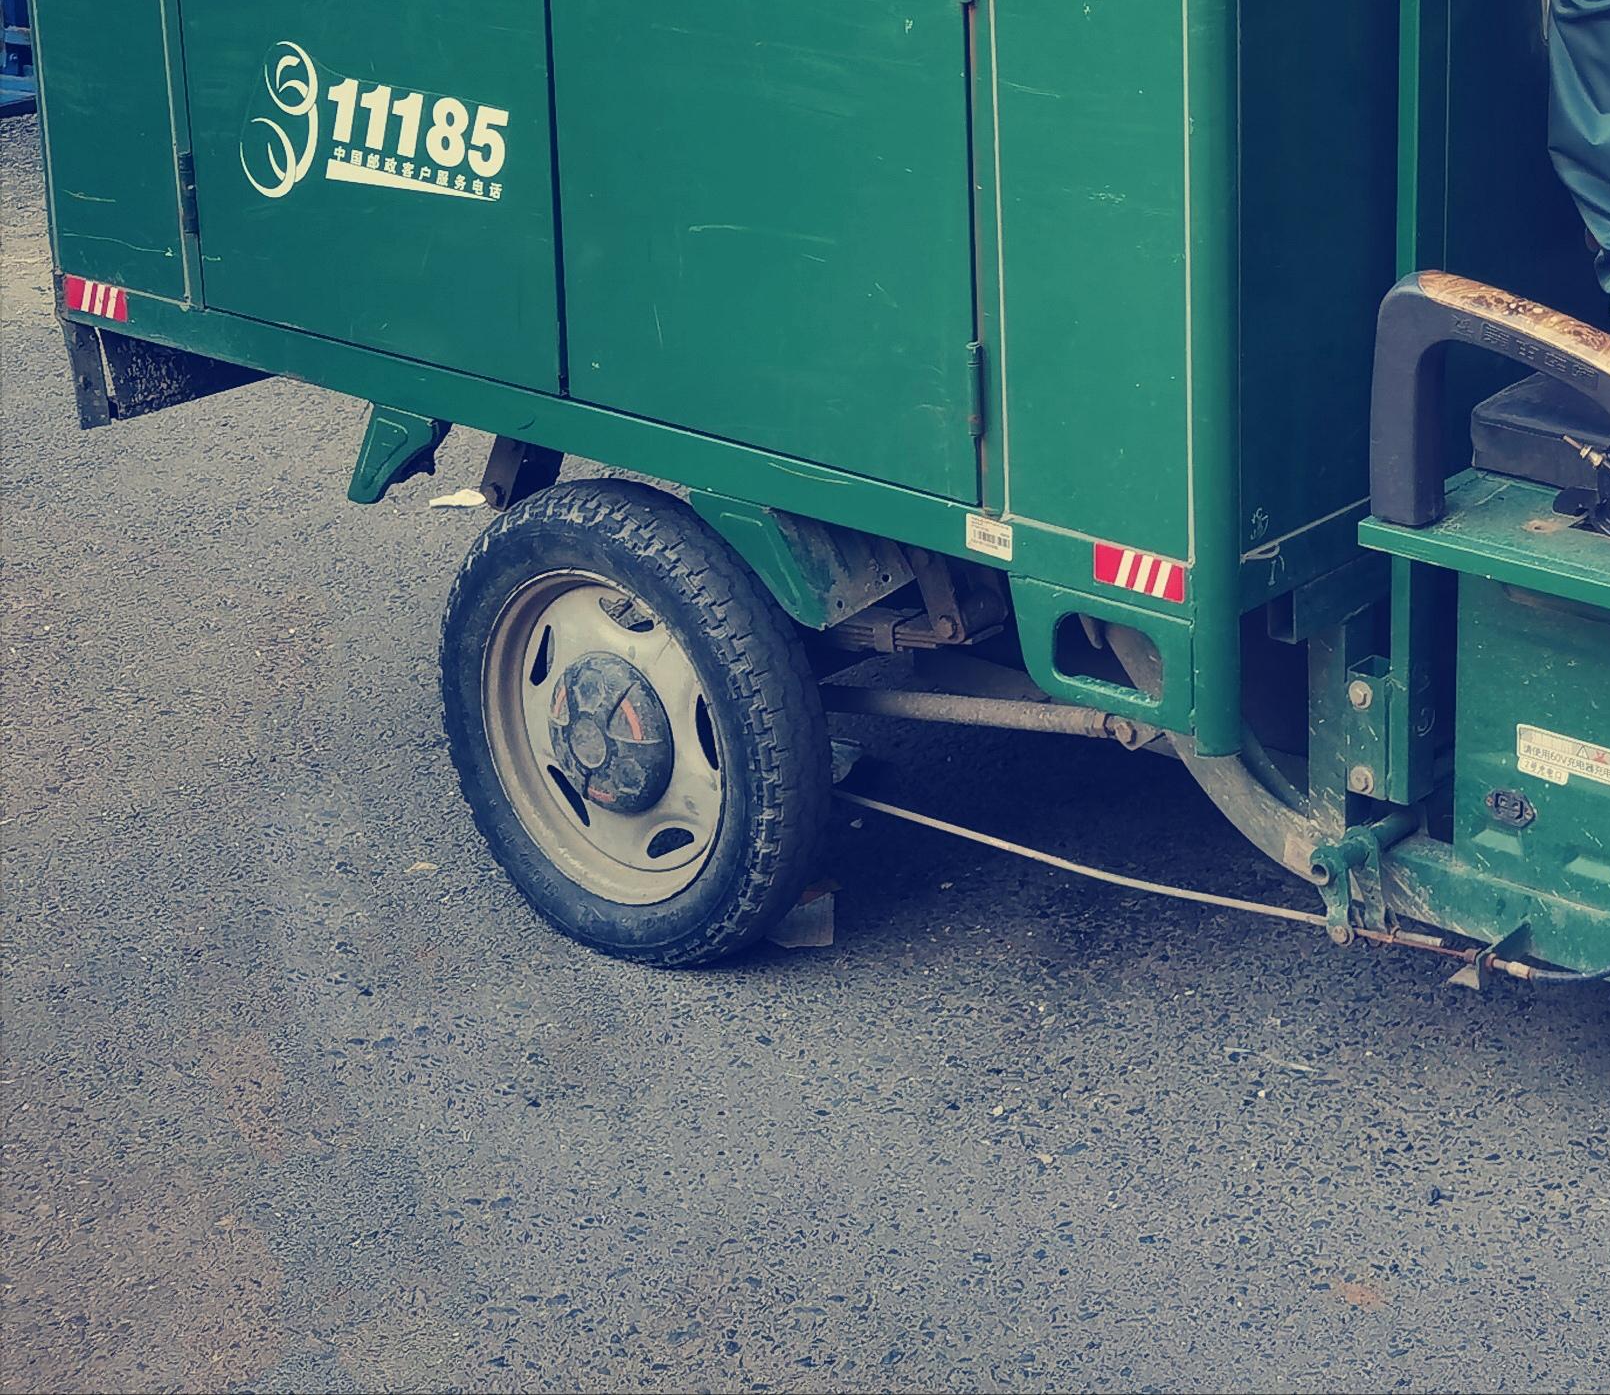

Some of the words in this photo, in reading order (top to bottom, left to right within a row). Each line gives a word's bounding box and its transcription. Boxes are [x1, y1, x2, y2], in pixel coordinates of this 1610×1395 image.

[327, 78, 510, 178] 11185
[333, 146, 503, 199] 中国邮政客户服务电话
